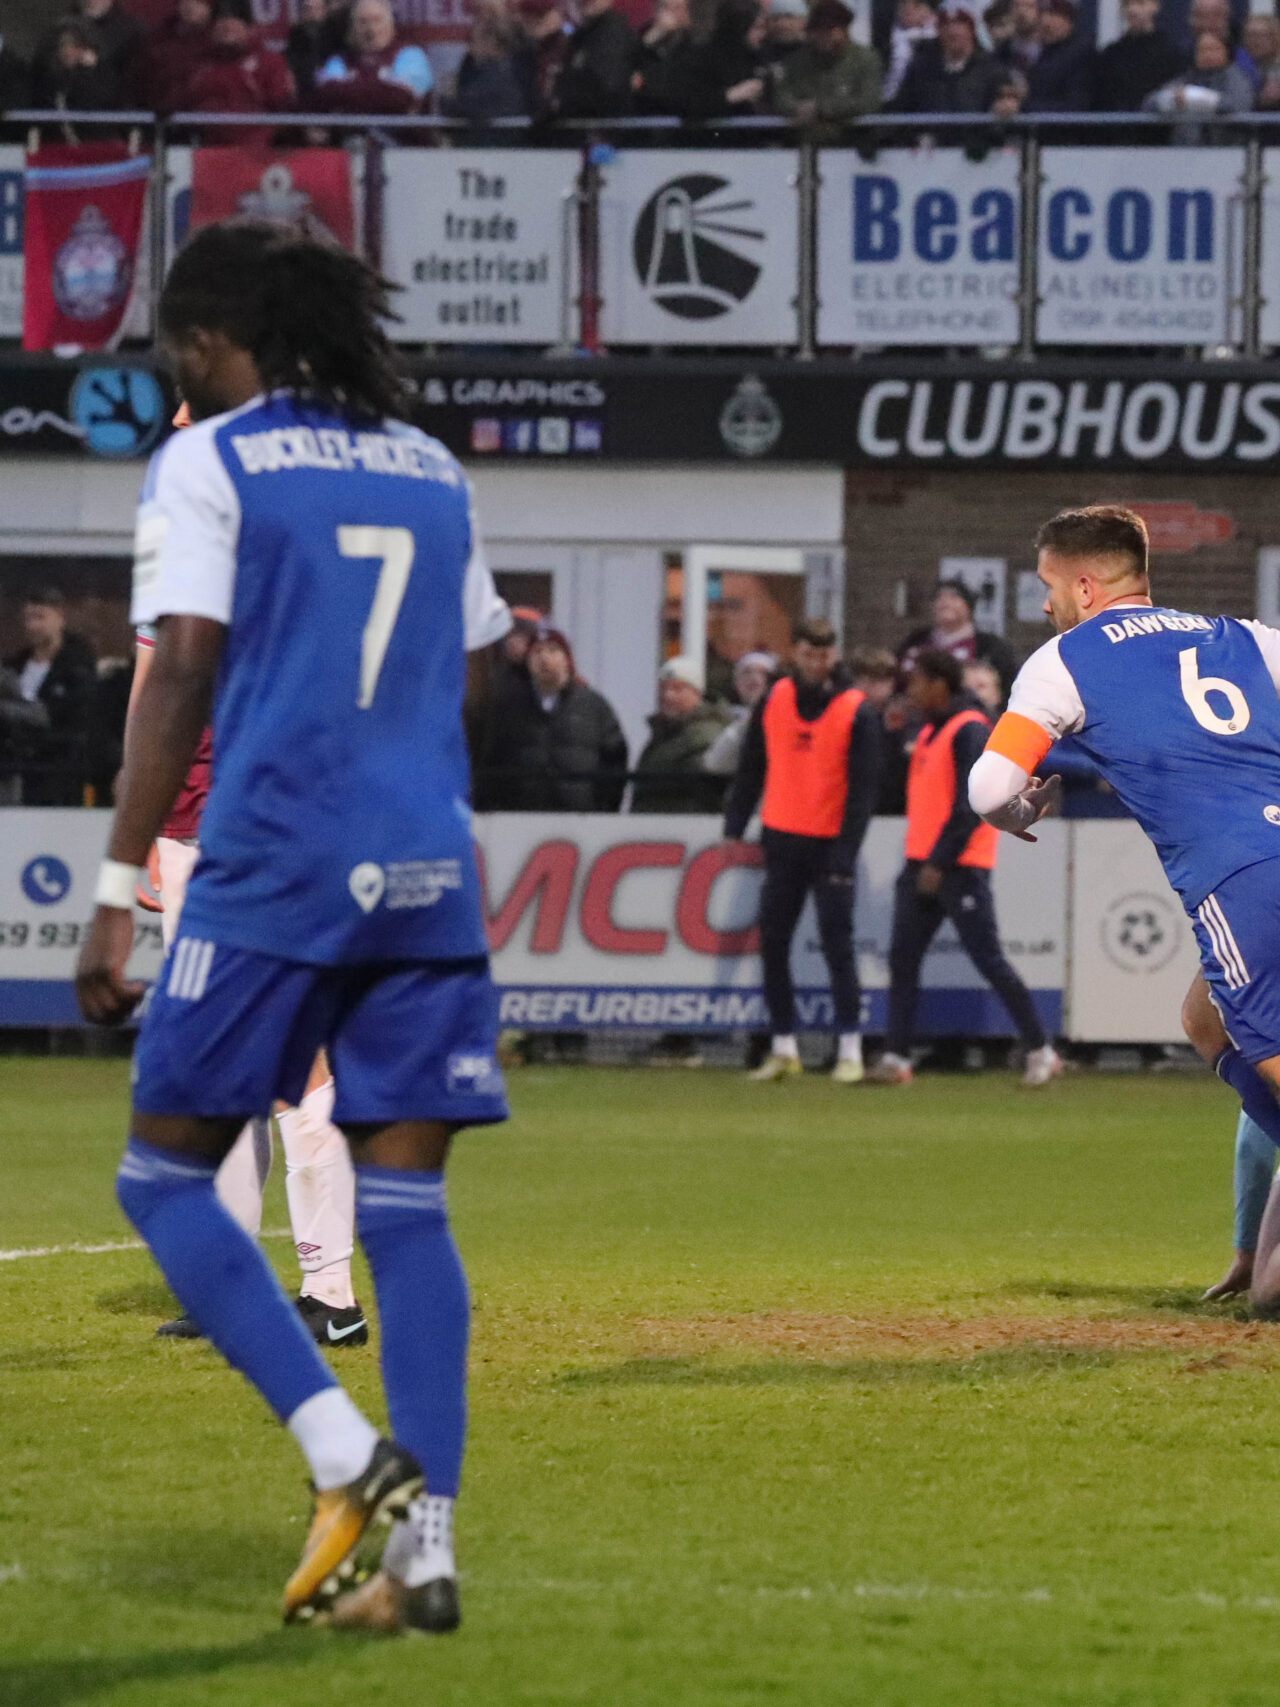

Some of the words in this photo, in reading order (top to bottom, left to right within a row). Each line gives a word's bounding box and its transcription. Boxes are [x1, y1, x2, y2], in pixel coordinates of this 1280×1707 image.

[459, 167, 506, 198] The
[445, 208, 518, 241] trade
[412, 253, 549, 284] electrical
[438, 295, 520, 325] outlet
[336, 524, 416, 710] 7
[1178, 646, 1251, 736] 6
